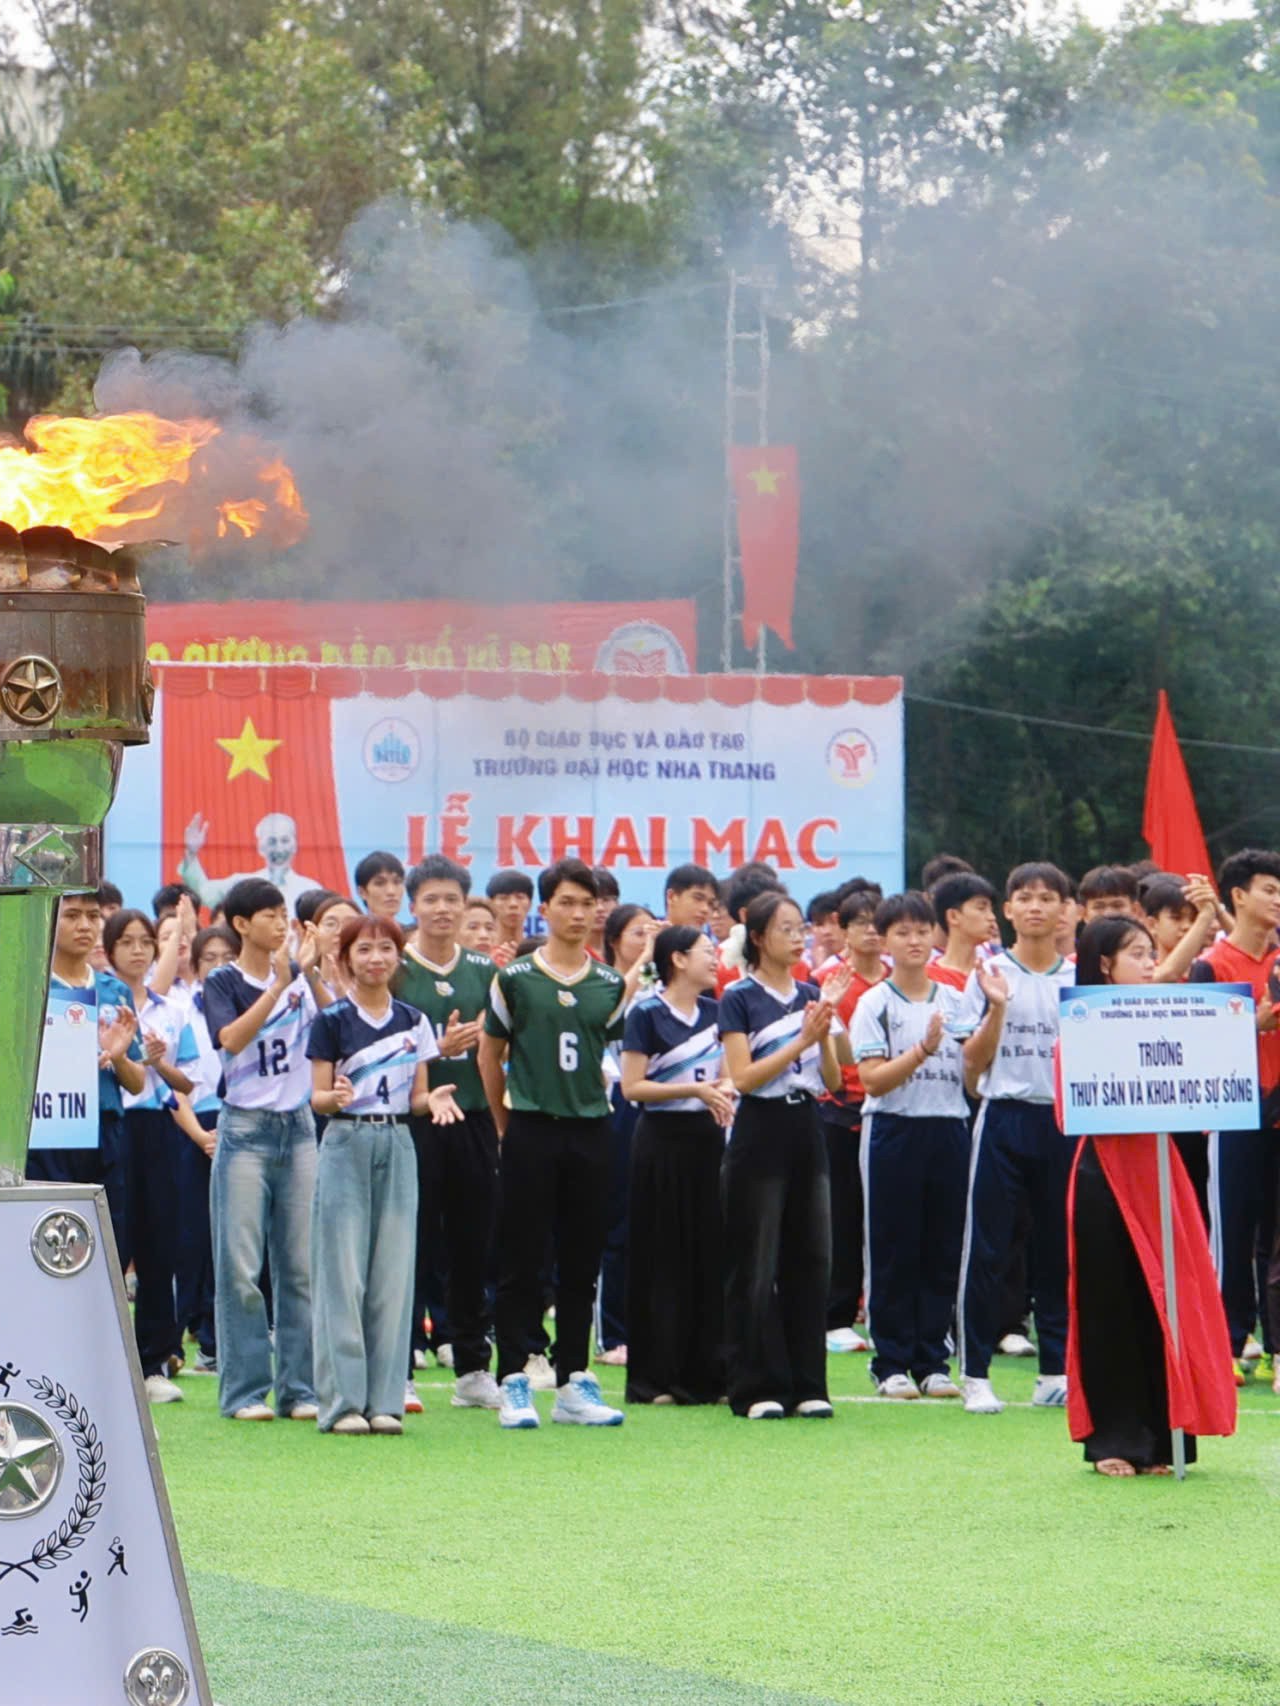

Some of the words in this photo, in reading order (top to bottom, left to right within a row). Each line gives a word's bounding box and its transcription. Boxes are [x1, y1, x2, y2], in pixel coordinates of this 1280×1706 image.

[472, 755, 558, 777] TRƯỜNG
[606, 759, 649, 783] HỌC
[656, 760, 702, 780] NHA
[707, 760, 776, 781] TRANG
[496, 814, 667, 868] KHAI
[466, 953, 491, 966] NTU
[506, 962, 532, 976] NTU
[596, 967, 620, 983] NTU
[256, 1038, 290, 1077] 12
[558, 1032, 579, 1072] 6
[1138, 1036, 1184, 1067] TRƯỜNG
[376, 1075, 390, 1105] 4
[1102, 1073, 1126, 1106] SẢN
[1128, 1075, 1144, 1106] VÀ
[1146, 1079, 1177, 1105] KHOA
[1179, 1078, 1202, 1110] HỌC
[1205, 1077, 1221, 1110] SỰ
[1222, 1070, 1253, 1103] SỐNG
[58, 1092, 86, 1119] TIN
